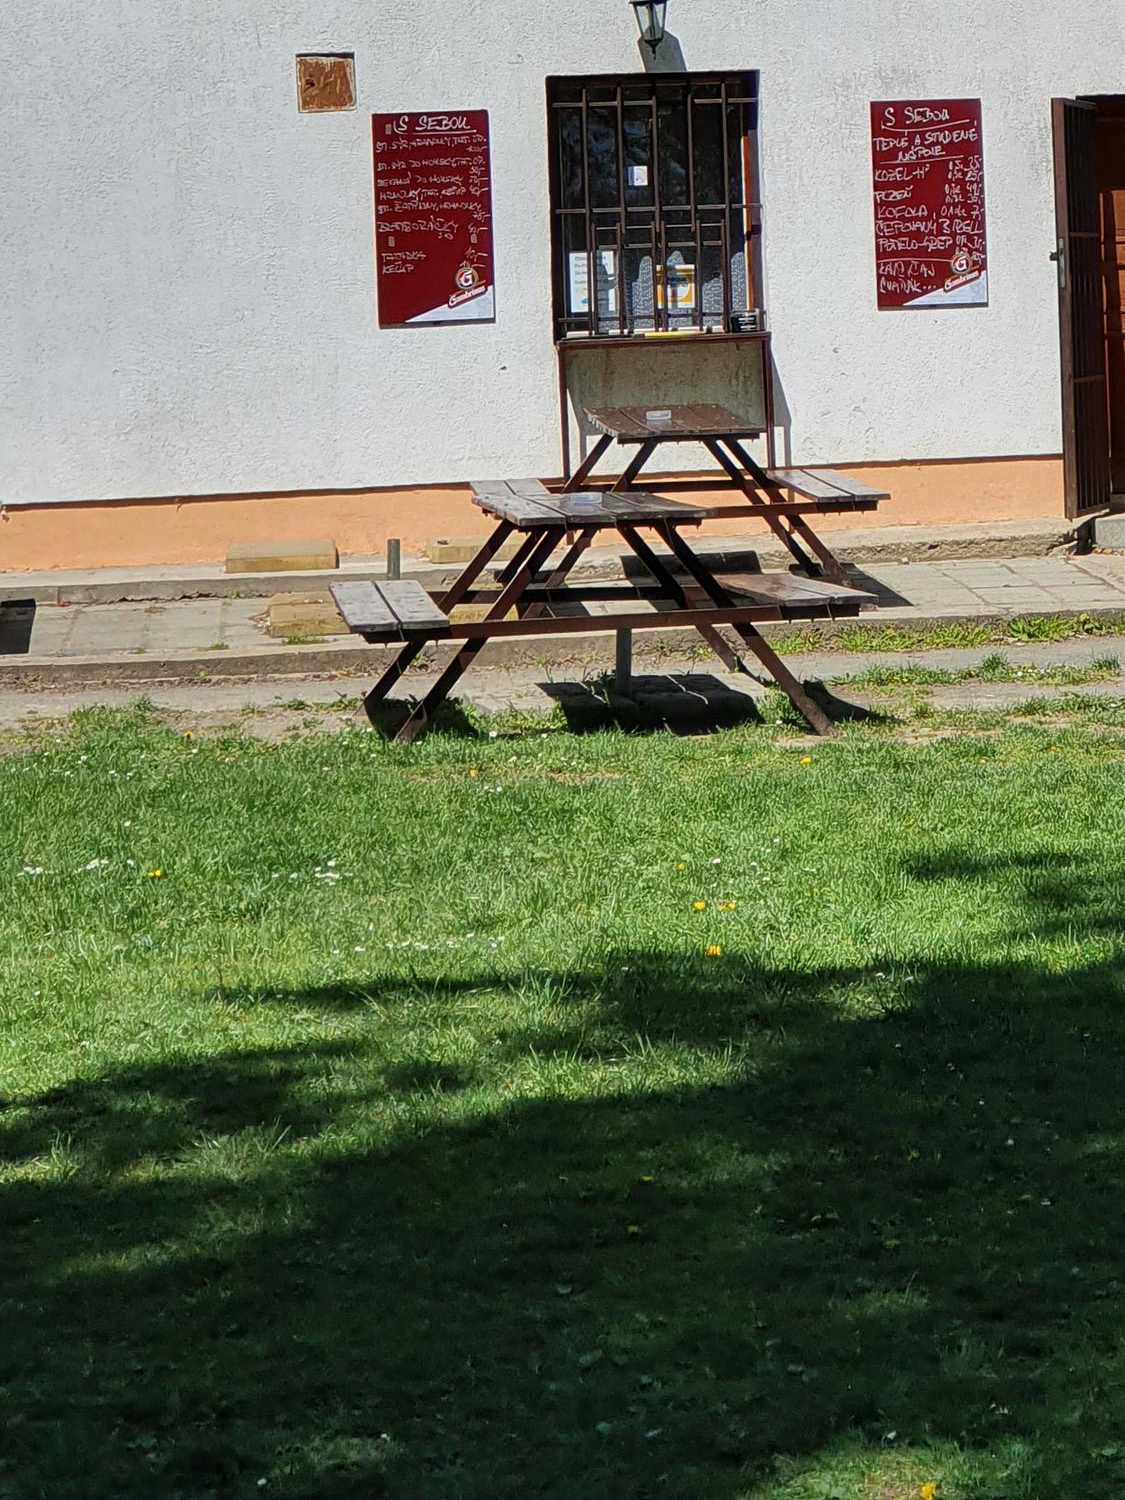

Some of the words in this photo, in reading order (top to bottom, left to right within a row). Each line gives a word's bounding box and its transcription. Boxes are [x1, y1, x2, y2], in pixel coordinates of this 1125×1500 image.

[397, 115, 409, 131] S
[415, 115, 471, 131] SEBOU
[885, 107, 896, 126] S
[904, 107, 950, 124] SEBOU
